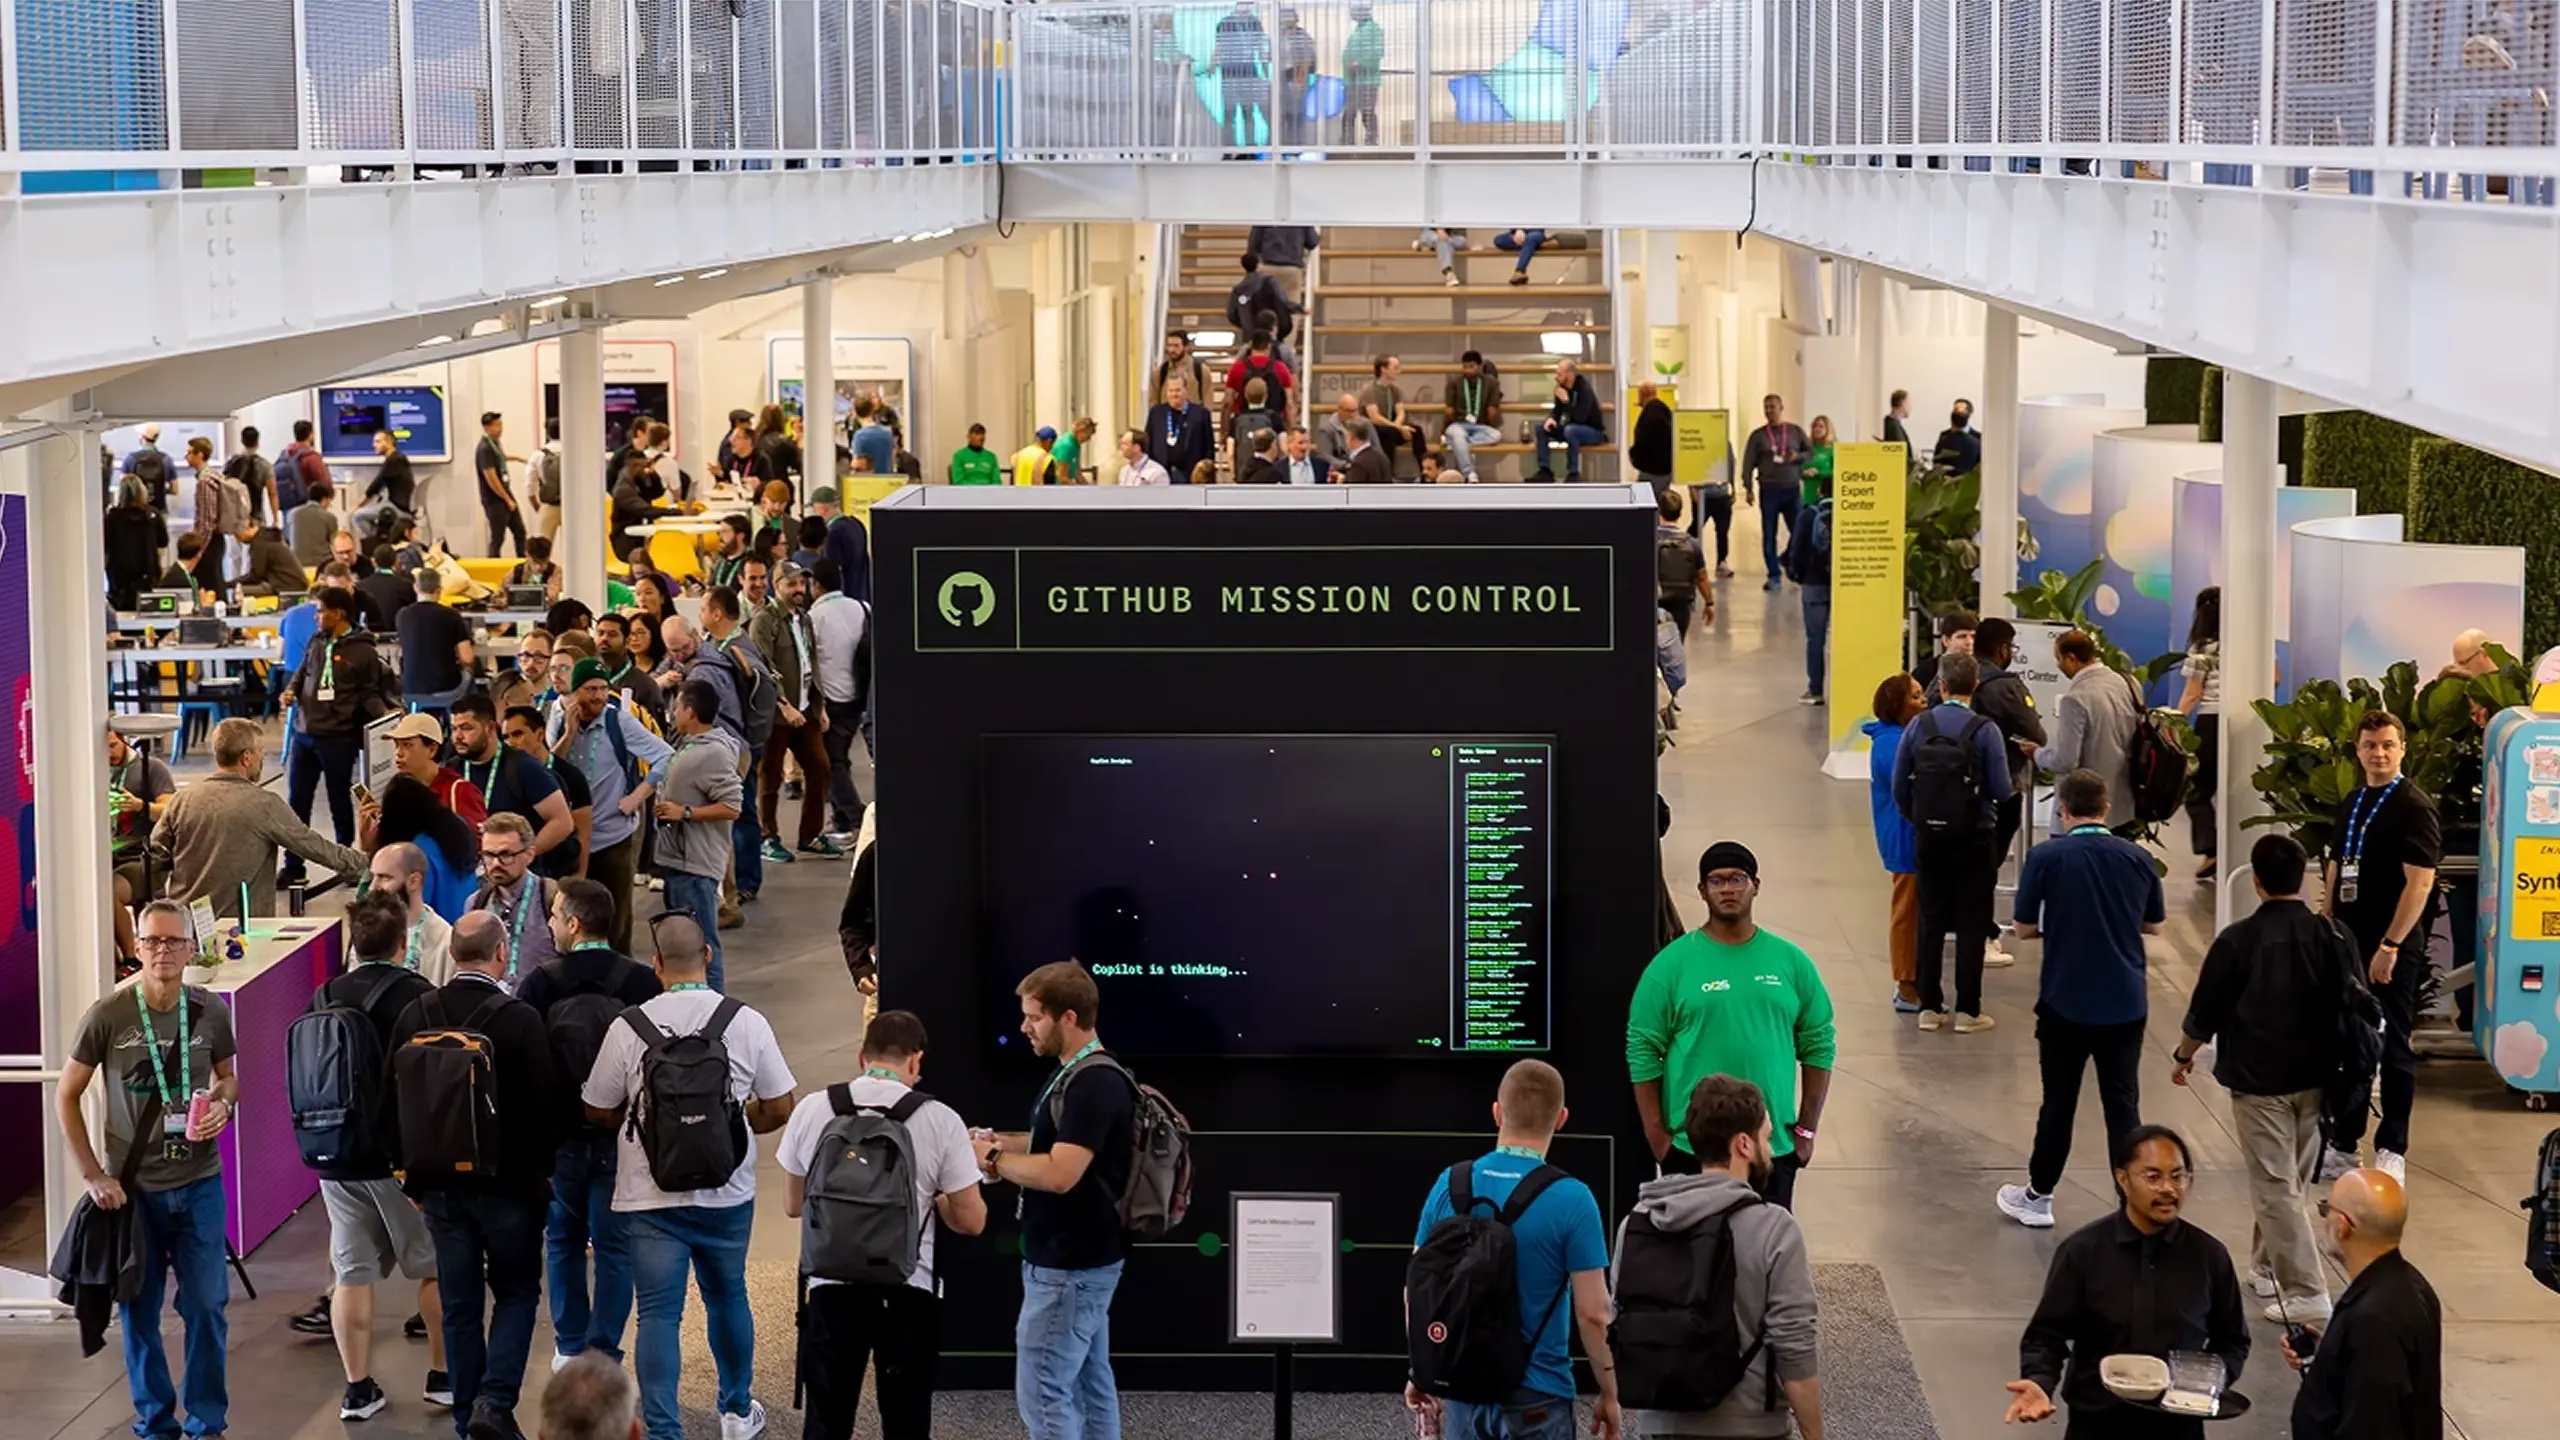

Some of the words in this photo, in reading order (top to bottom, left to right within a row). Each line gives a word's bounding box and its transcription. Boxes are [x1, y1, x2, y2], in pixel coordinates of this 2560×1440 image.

[1841, 471, 1878, 483] GitHub
[1841, 486, 1875, 498] Expert
[1841, 500, 1875, 511] Center
[1048, 586, 1192, 613] GITHUB
[1221, 585, 1390, 613] MISSION
[1411, 585, 1581, 612] CONTROL
[2027, 669, 2058, 682] Center
[1092, 963, 1143, 977] Copilot
[1150, 963, 1164, 975] is
[1170, 963, 1248, 977] thinking...
